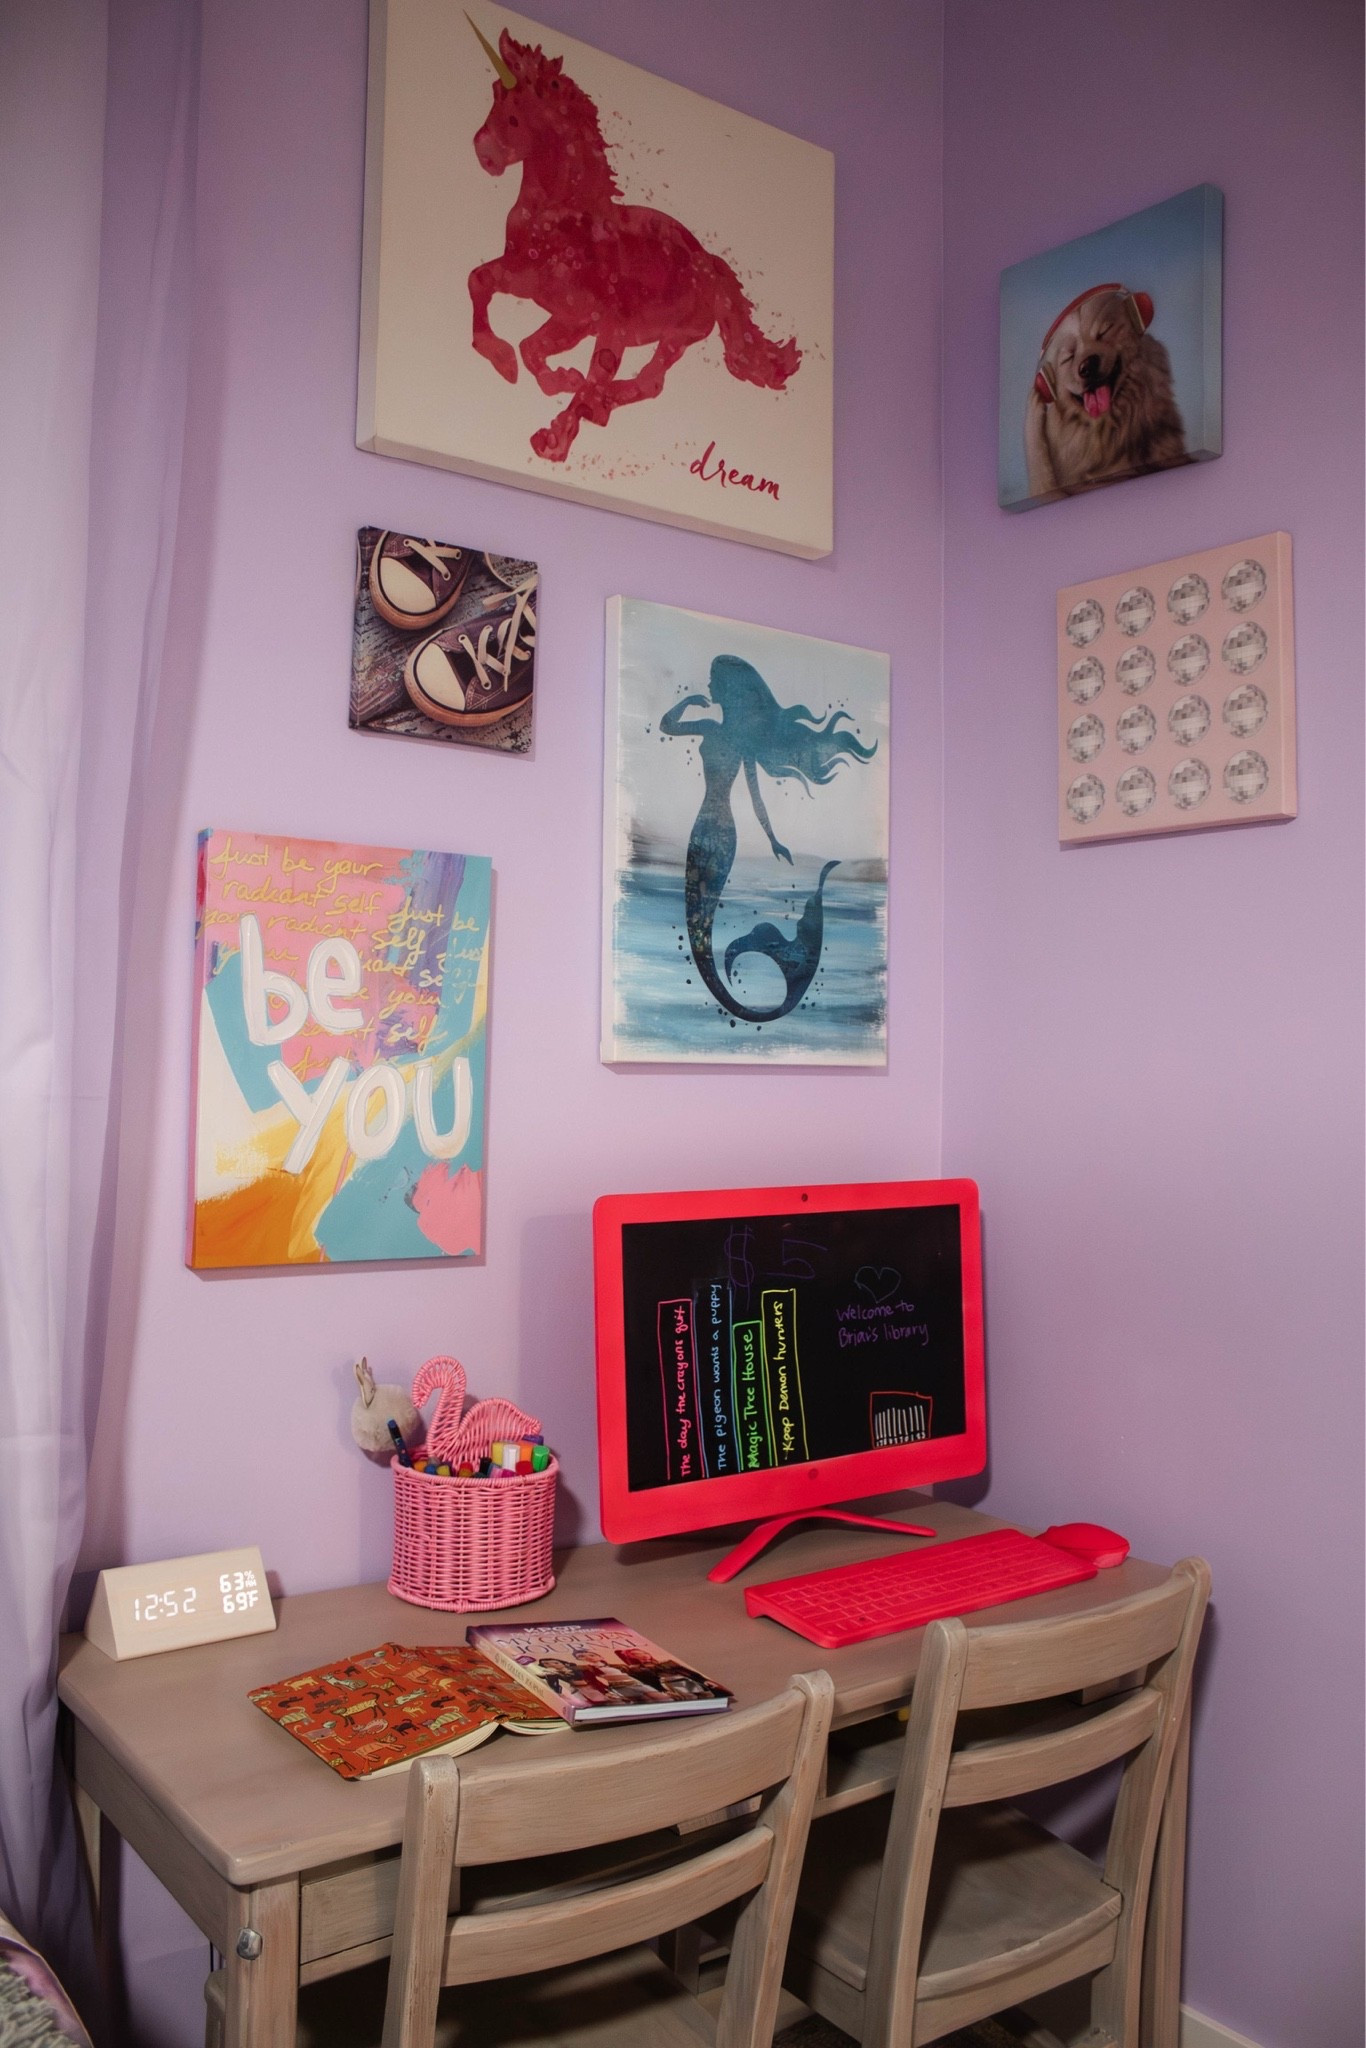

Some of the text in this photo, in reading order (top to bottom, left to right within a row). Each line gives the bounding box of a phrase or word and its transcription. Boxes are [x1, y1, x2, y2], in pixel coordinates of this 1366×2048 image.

[690, 440, 779, 500] dream
[282, 846, 315, 876] be
[318, 859, 384, 894] your
[452, 911, 480, 931] be
[239, 911, 364, 1046] be
[673, 1305, 689, 1334] quit
[836, 1299, 916, 1322] Welcome to
[883, 1323, 930, 1346] library
[675, 1339, 689, 1391] crayons
[710, 1283, 728, 1471] The pigeon wants a puppy
[772, 1300, 796, 1452] Kpop Demon hunters
[741, 1328, 763, 1468] Magic Tree House
[676, 1419, 692, 1448] day
[680, 1453, 691, 1477] The
[134, 1587, 197, 1621] 12:52
[496, 1634, 533, 1646] MY
[538, 1631, 634, 1644] GOLDEN
[516, 1638, 638, 1654] JOURNAL
